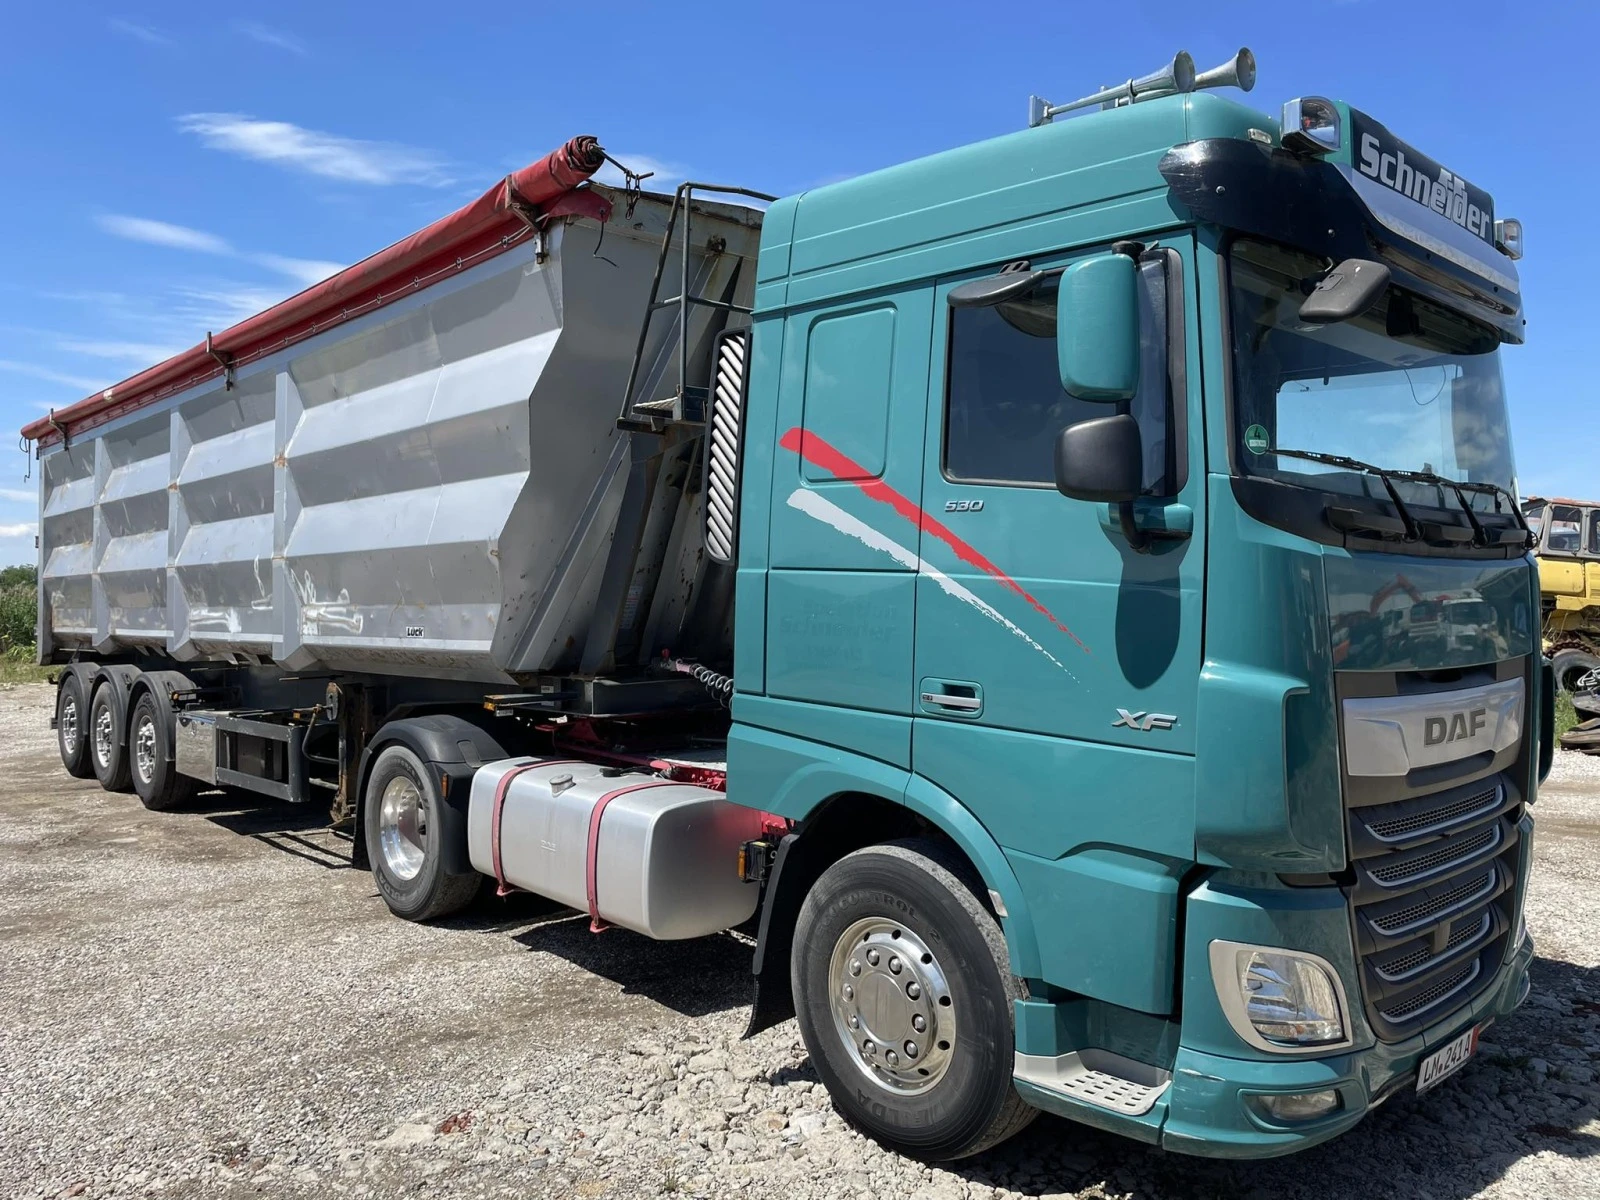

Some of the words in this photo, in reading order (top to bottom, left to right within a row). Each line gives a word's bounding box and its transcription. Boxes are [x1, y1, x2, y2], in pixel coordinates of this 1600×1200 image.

[1360, 132, 1490, 239] Schneider
[945, 500, 984, 512] 530
[1111, 708, 1178, 731] XF
[1424, 707, 1486, 747] DAF
